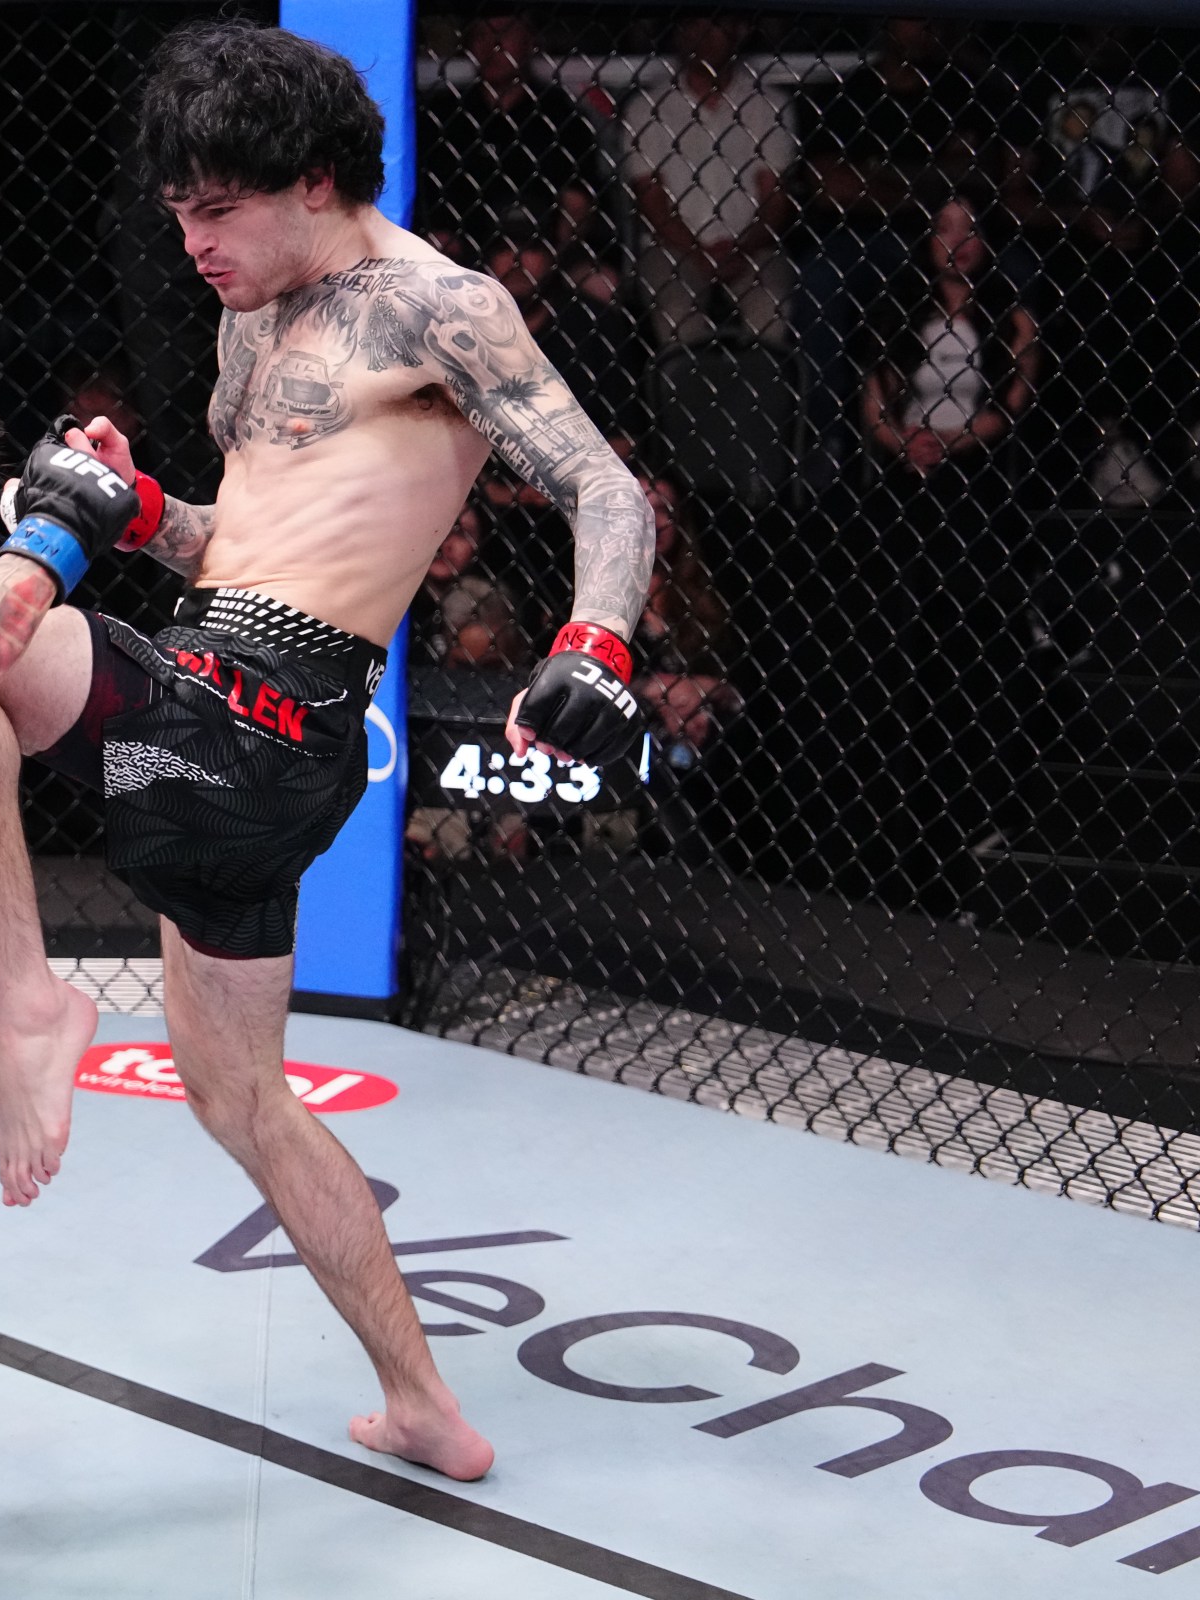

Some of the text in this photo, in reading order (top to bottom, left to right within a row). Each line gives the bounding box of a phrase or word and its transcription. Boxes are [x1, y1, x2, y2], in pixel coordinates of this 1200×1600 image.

[49, 447, 129, 499] UFC
[558, 627, 629, 674] NSAC
[570, 660, 638, 720] UFC
[439, 743, 602, 804] 4:33
[78, 1072, 187, 1098] wireles
